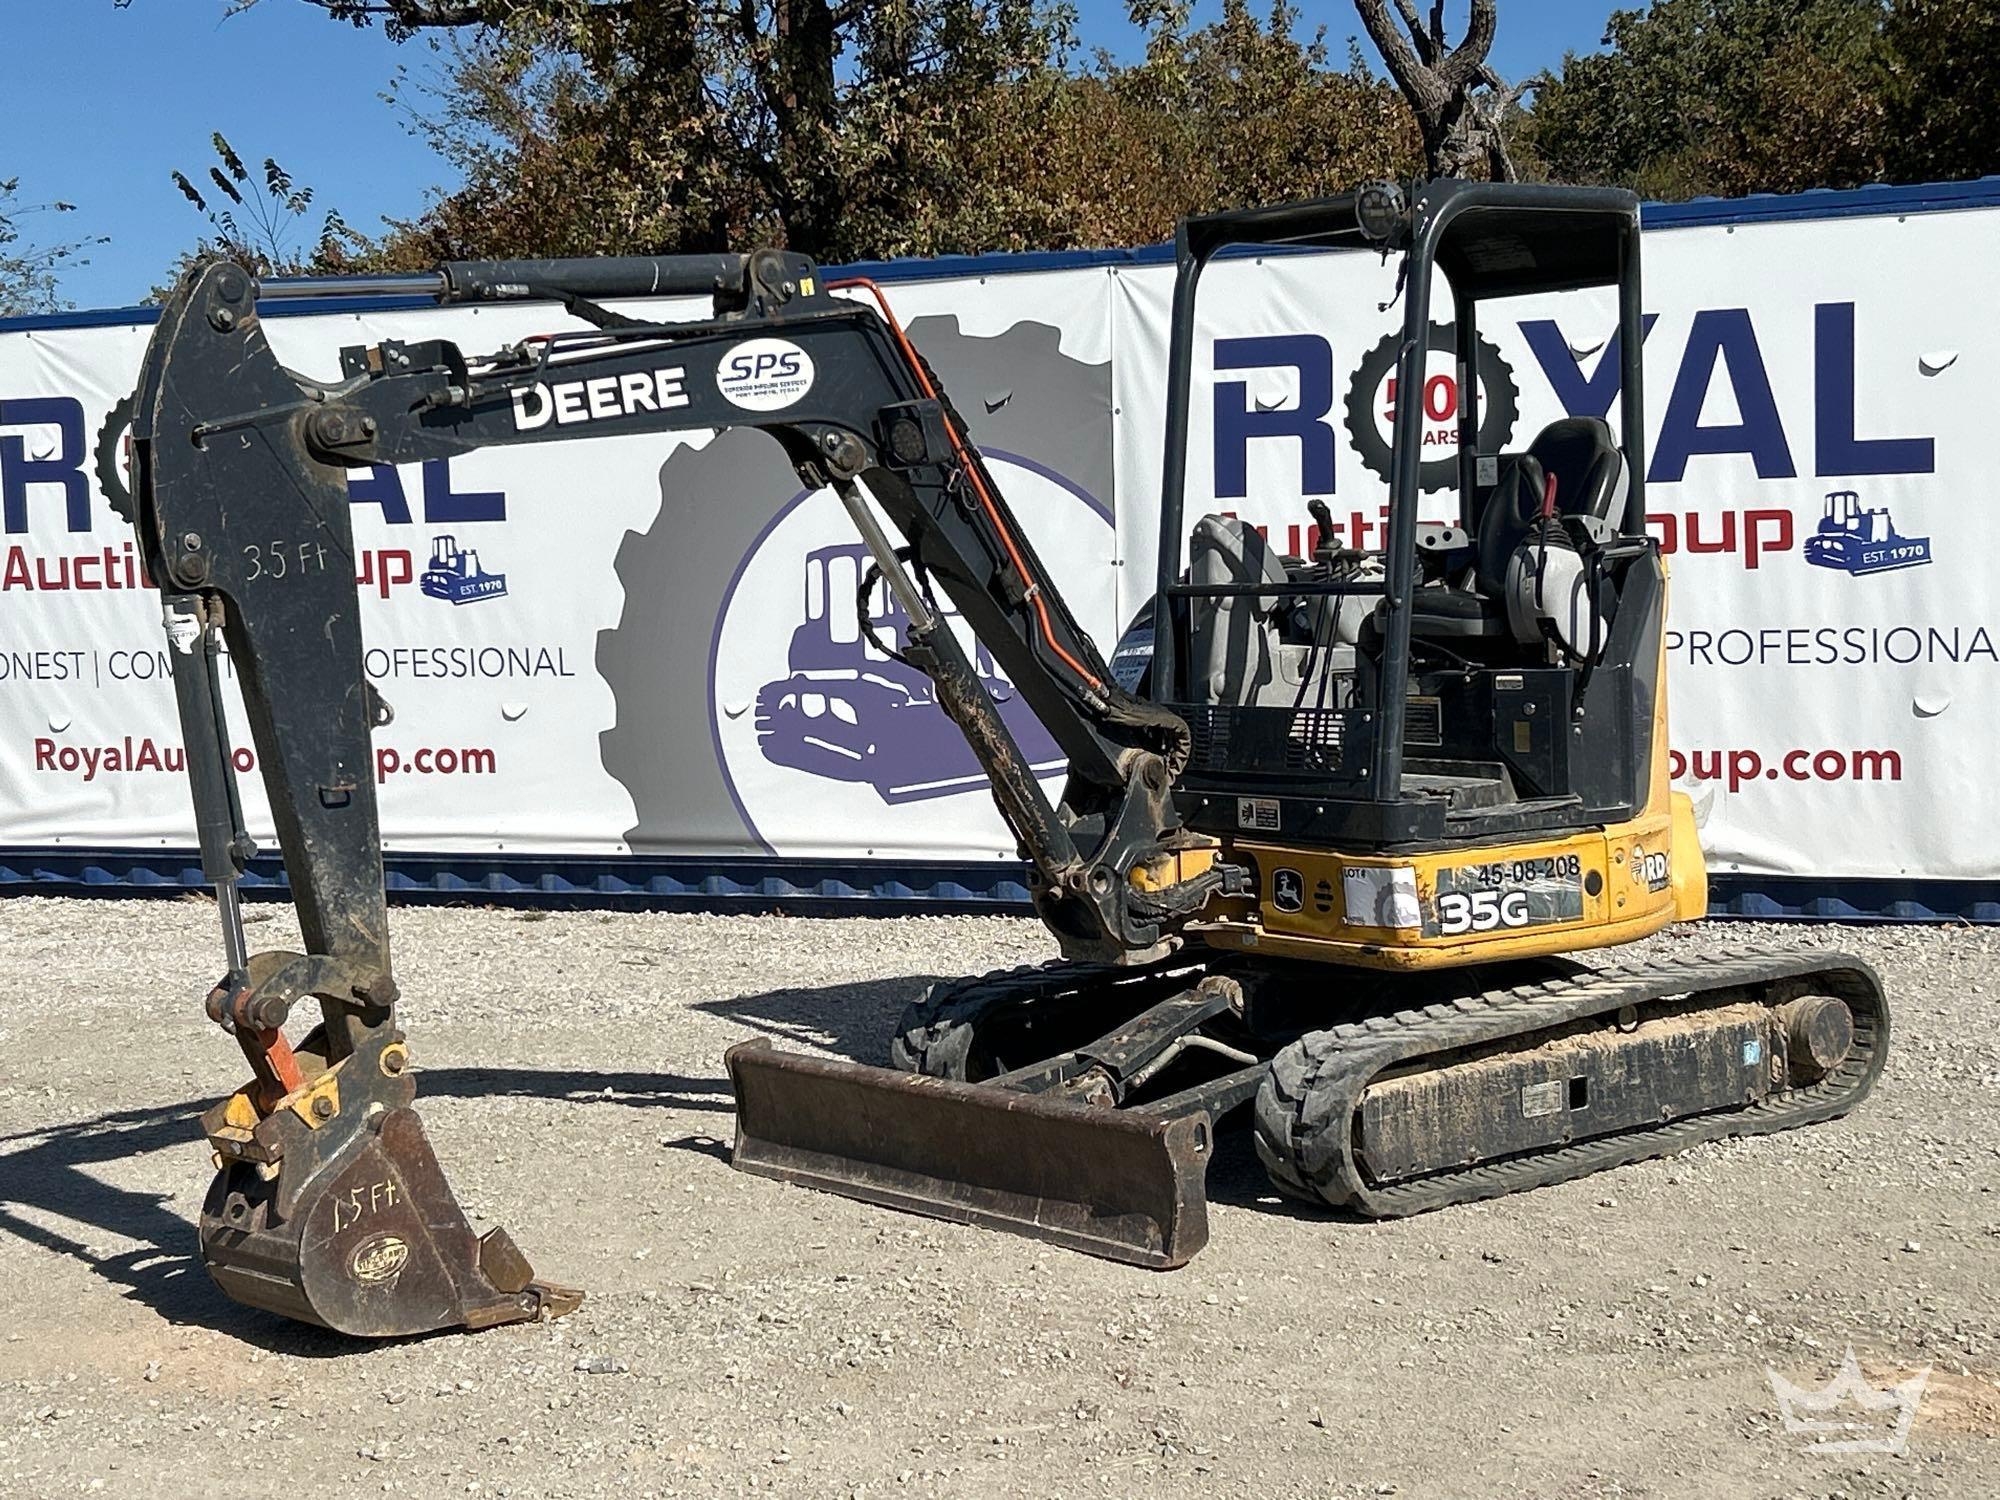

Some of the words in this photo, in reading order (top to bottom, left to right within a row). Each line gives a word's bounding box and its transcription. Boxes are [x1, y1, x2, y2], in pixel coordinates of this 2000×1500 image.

[722, 352, 800, 382] SPS
[511, 367, 689, 430] DEERE
[243, 540, 287, 581] 3.5
[298, 542, 328, 574] Ft
[1862, 550, 1889, 564] EST.
[1890, 544, 1924, 560] 1970
[460, 583, 479, 596] EST.
[479, 579, 503, 592] 1970
[1477, 856, 1580, 886] 45-08-208
[1439, 891, 1529, 935] 35G
[334, 1186, 365, 1234] 1.5
